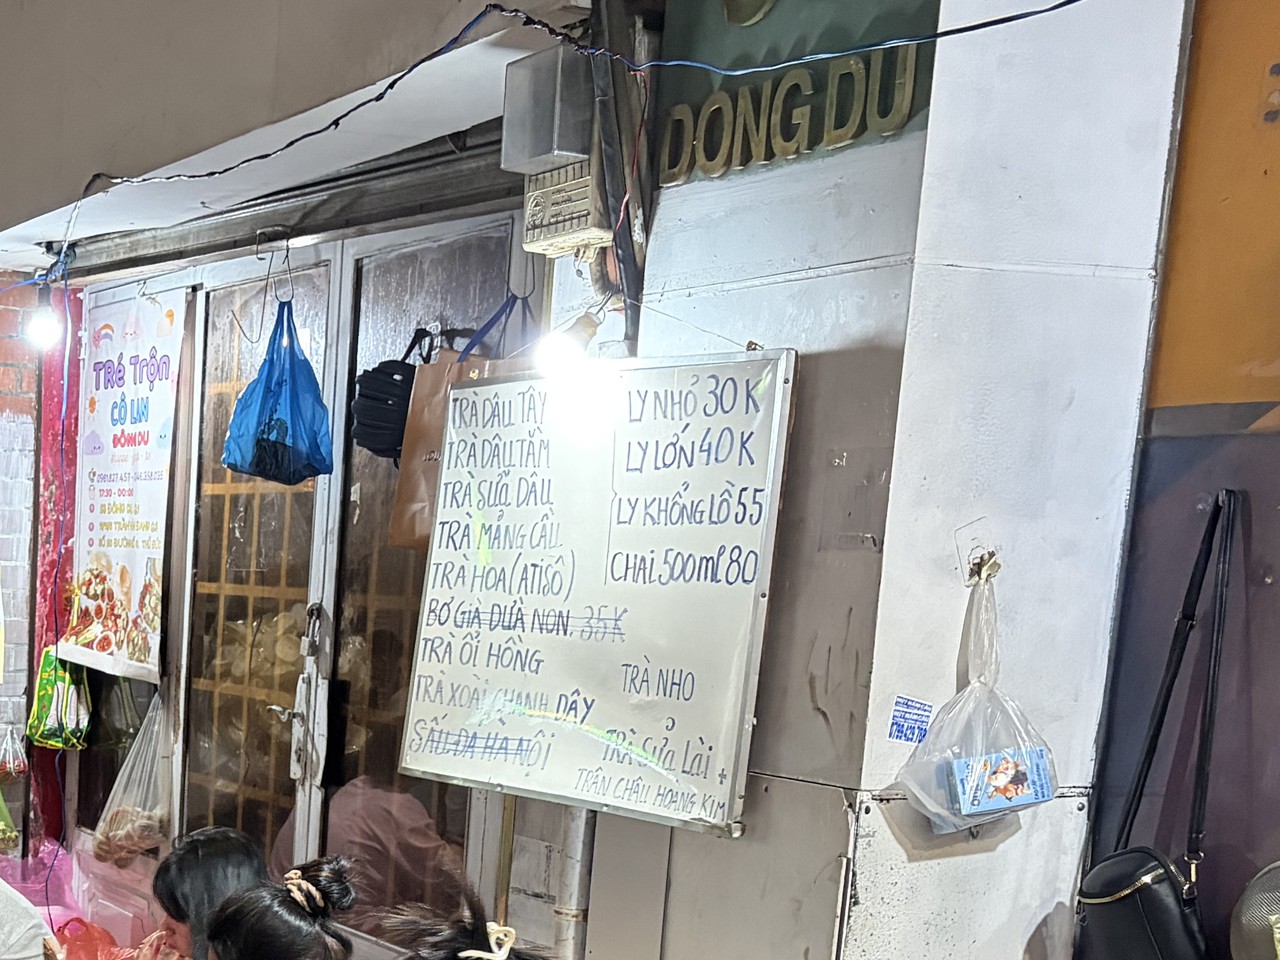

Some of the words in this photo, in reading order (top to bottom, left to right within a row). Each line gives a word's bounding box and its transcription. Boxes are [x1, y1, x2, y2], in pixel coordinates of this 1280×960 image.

[824, 43, 918, 150] DU
[111, 391, 128, 427] CÔ
[451, 391, 479, 429] TRÀ
[482, 392, 515, 429] DÂU
[517, 385, 548, 425] TÂY
[628, 389, 648, 422] LY
[653, 374, 699, 421] NHỎ
[138, 430, 150, 447] DU
[447, 432, 478, 470] TRÀ
[481, 433, 515, 469] DÂU
[626, 441, 648, 473] LY
[654, 423, 695, 470] LỚN
[442, 471, 475, 510] TRÀ
[516, 471, 554, 508] DÂU
[616, 497, 639, 526] LY
[708, 480, 735, 526] LỒ
[735, 486, 765, 526] 55
[438, 511, 472, 552] TRÀ
[476, 509, 527, 550] MẢNG
[529, 507, 563, 550] CẦU
[431, 553, 470, 590] TRÀ
[725, 544, 759, 586] 80
[421, 632, 452, 665] TRÀ
[486, 635, 545, 675] HỒNG
[415, 670, 446, 706] TRÀ
[554, 688, 596, 725] DÂY
[621, 655, 651, 697] TRÀ
[656, 668, 696, 702] NHO
[574, 766, 613, 797] TRÂN
[613, 775, 652, 805] CHÂU
